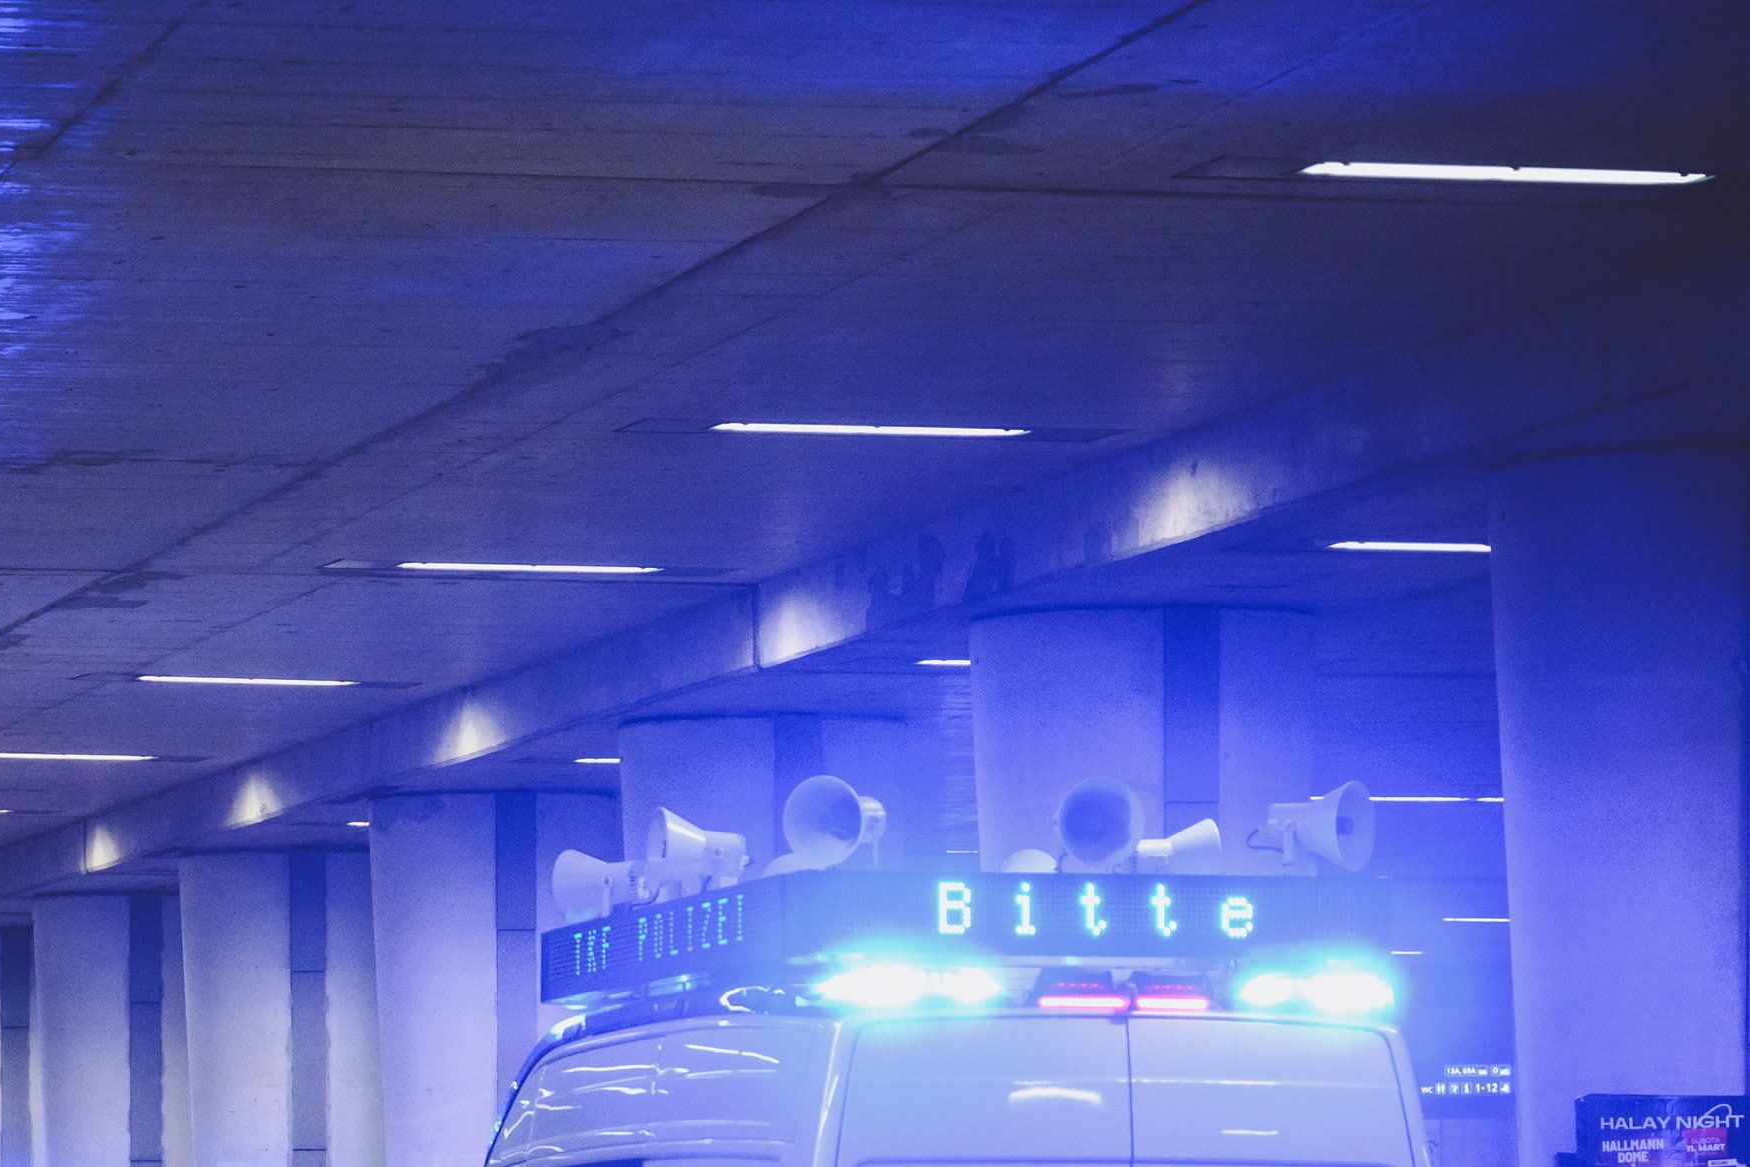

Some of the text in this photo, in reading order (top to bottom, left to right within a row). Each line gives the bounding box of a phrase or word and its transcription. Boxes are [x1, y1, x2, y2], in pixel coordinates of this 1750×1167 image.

[937, 880, 1254, 938] Bitte
[637, 894, 744, 963] POLIZEI
[1421, 1086, 1433, 1094] WC
[1600, 1107, 1745, 1130] HALAY NIGHT
[1602, 1138, 1665, 1152] HALLMANN
[1691, 1136, 1721, 1144] SUBOTA
[1697, 1143, 1725, 1152] MART
[1617, 1151, 1649, 1163] DOME
